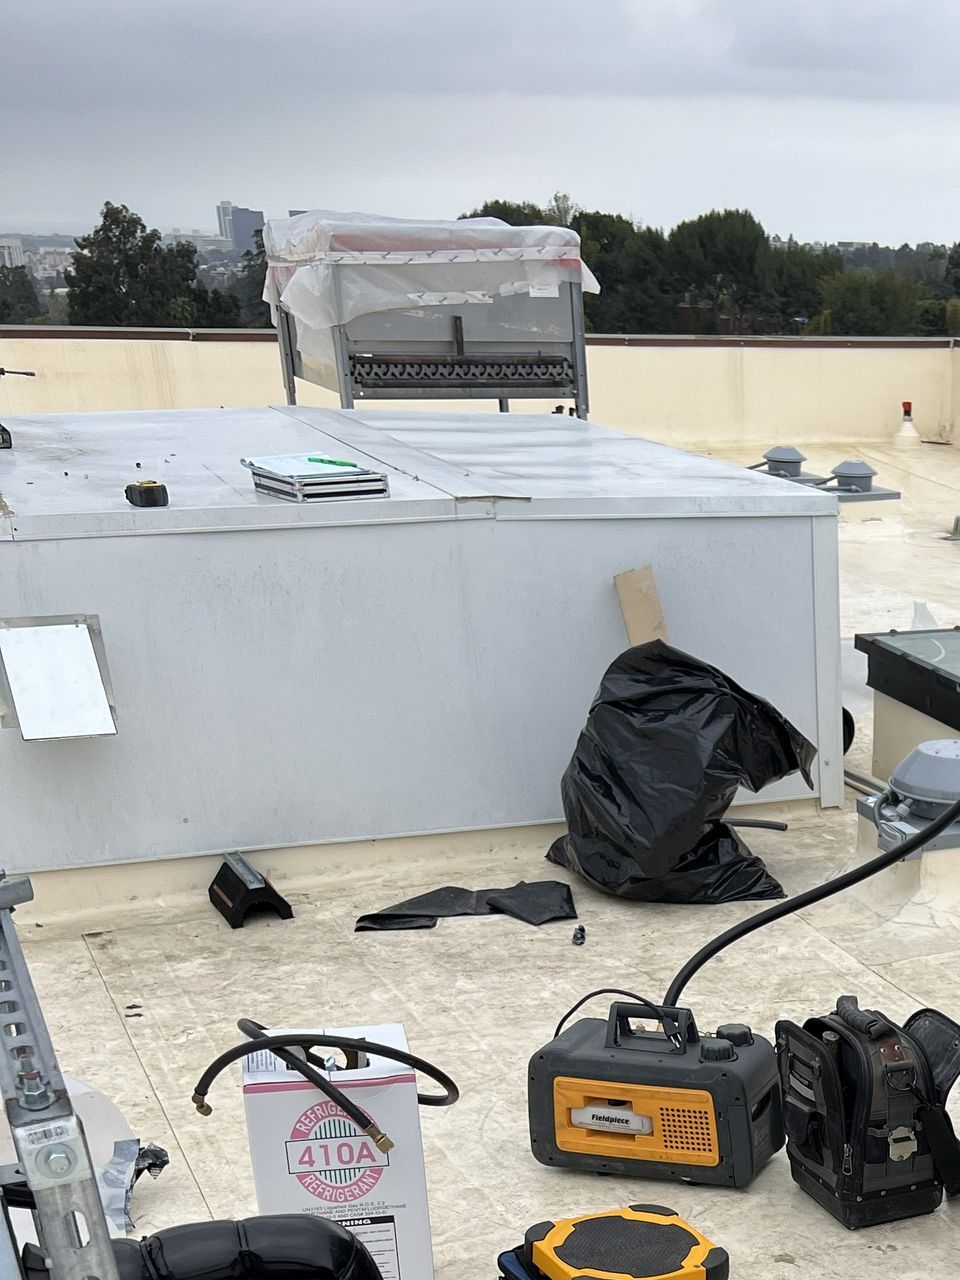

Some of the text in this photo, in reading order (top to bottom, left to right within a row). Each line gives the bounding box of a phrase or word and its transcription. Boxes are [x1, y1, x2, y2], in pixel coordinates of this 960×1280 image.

[295, 1102, 374, 1133] REFRIGE
[591, 1114, 630, 1125] Fieldpiece
[298, 1141, 377, 1168] 410A
[302, 1169, 379, 1201] REFRIGERANT
[337, 1218, 372, 1227] NING
